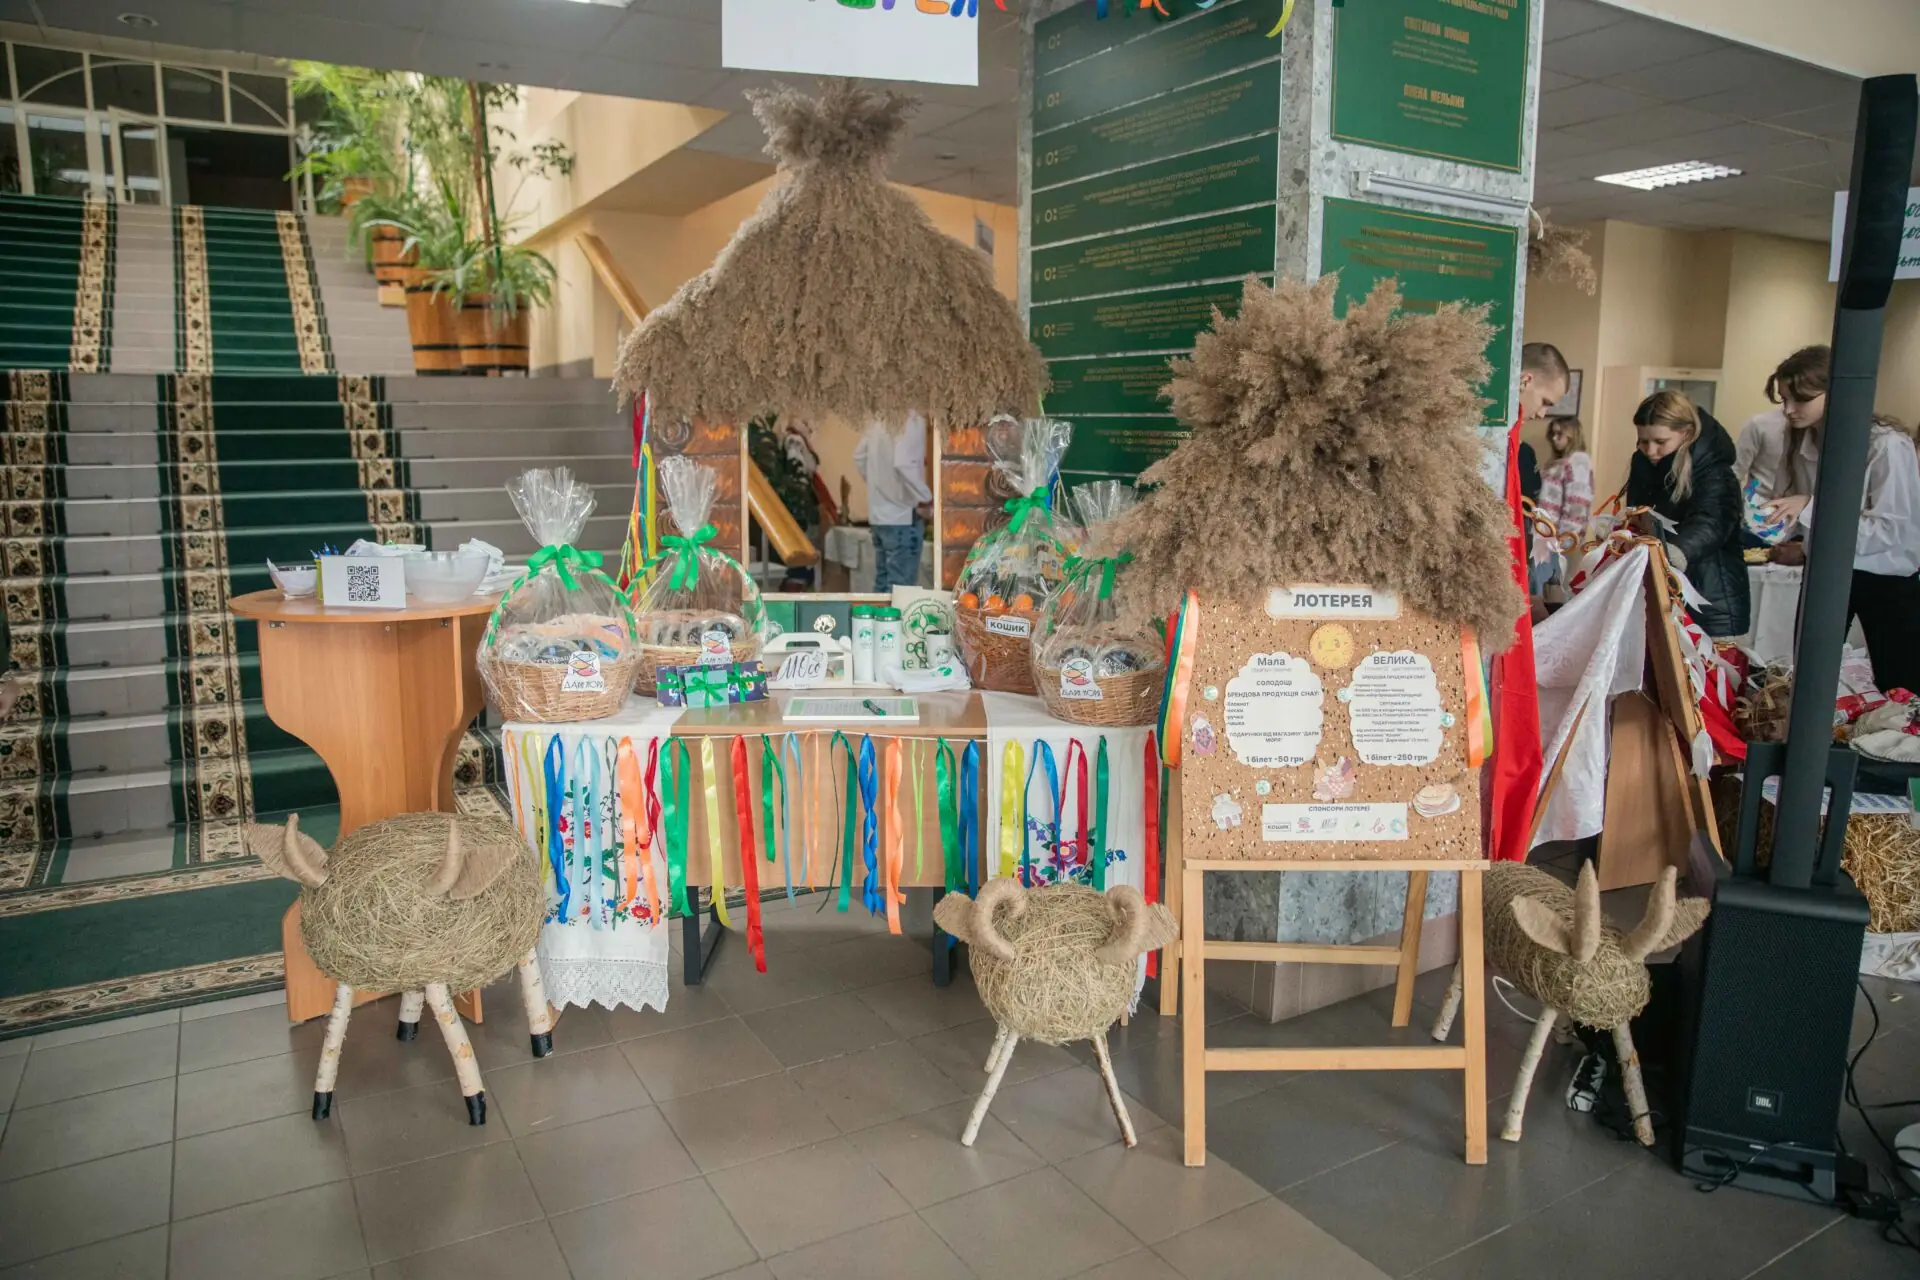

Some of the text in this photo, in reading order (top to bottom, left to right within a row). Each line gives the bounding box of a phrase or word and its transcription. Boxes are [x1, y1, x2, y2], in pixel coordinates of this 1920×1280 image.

[1293, 594, 1373, 608] ЛОТЕРЕЯ
[989, 622, 1026, 633] КОШИК
[1257, 657, 1286, 666] Мала
[1373, 656, 1417, 665] ВЕЛИКА
[1290, 757, 1304, 765] грн
[1755, 1096, 1772, 1108] JBL
